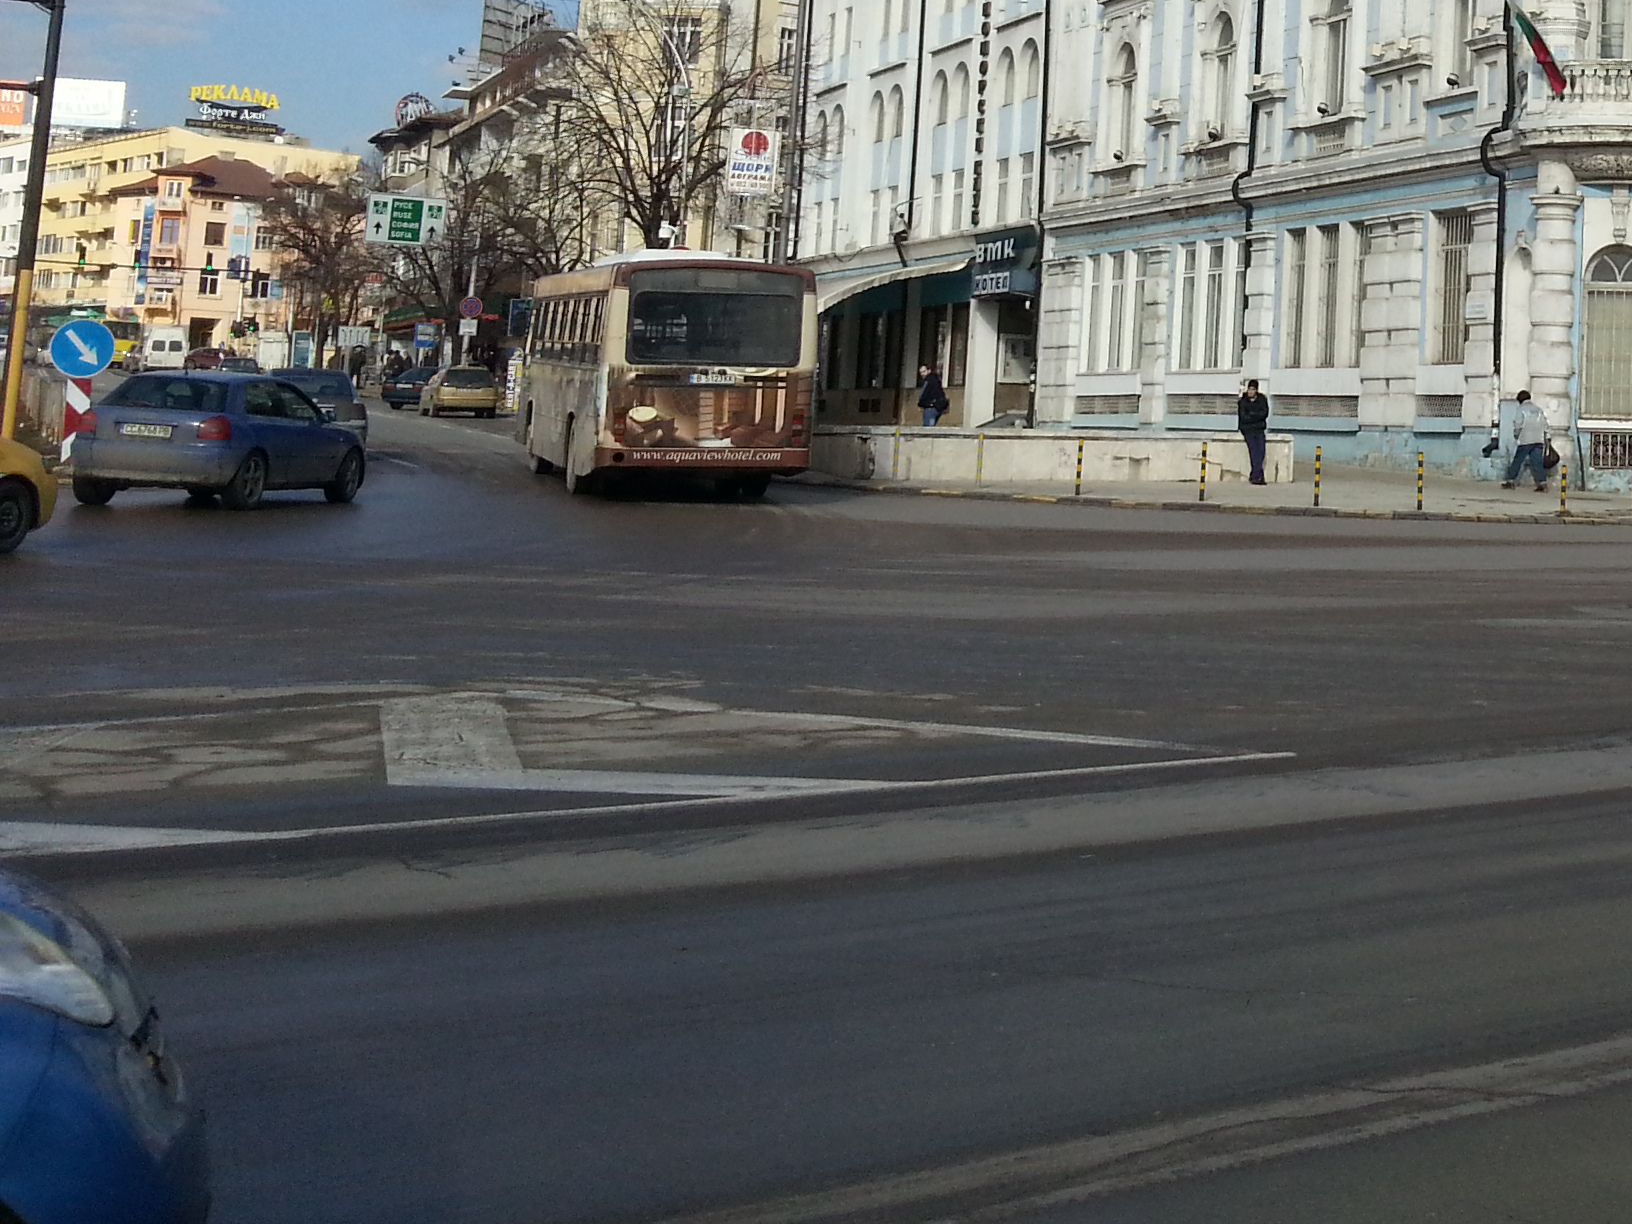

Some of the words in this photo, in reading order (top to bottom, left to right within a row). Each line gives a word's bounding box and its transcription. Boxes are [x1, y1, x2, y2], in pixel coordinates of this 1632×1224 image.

[190, 84, 280, 110] РЕКЛАМА
[199, 103, 238, 118] Форте
[393, 201, 414, 209] РУСЕ
[632, 449, 782, 464] www.aquaviewhotel.com
